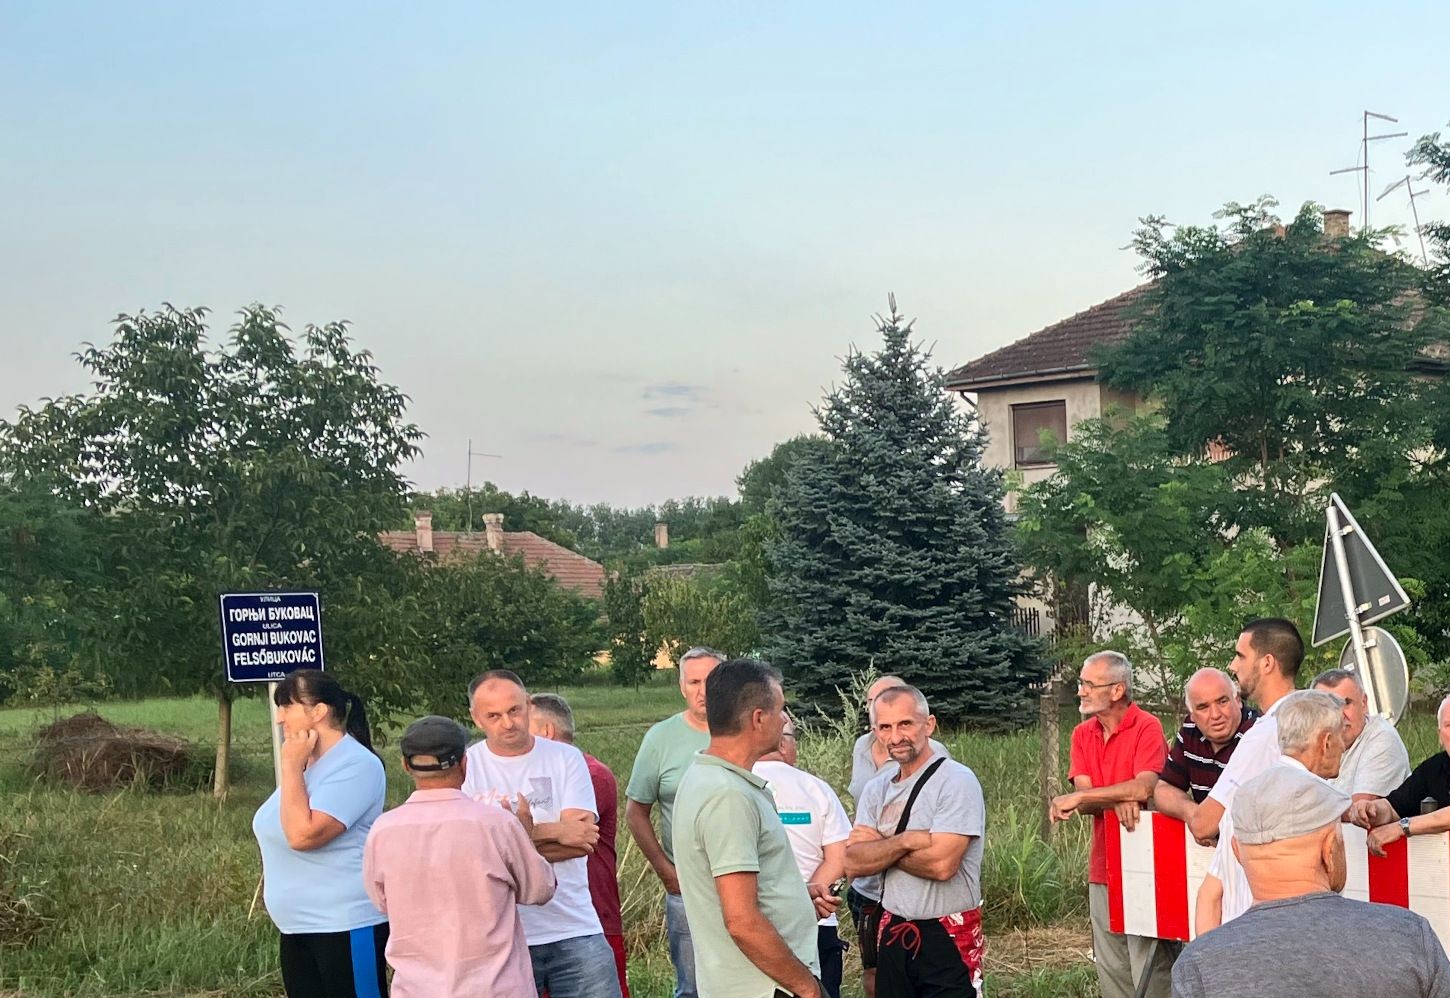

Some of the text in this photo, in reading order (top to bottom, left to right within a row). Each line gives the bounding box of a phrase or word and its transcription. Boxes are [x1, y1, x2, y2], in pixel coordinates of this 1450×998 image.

[229, 606, 314, 621] ГОРЊИ БУКОВАЦ
[232, 630, 316, 646] GORNJI BUKOVAC
[233, 645, 316, 666] FELSŐBUKOVÁC
